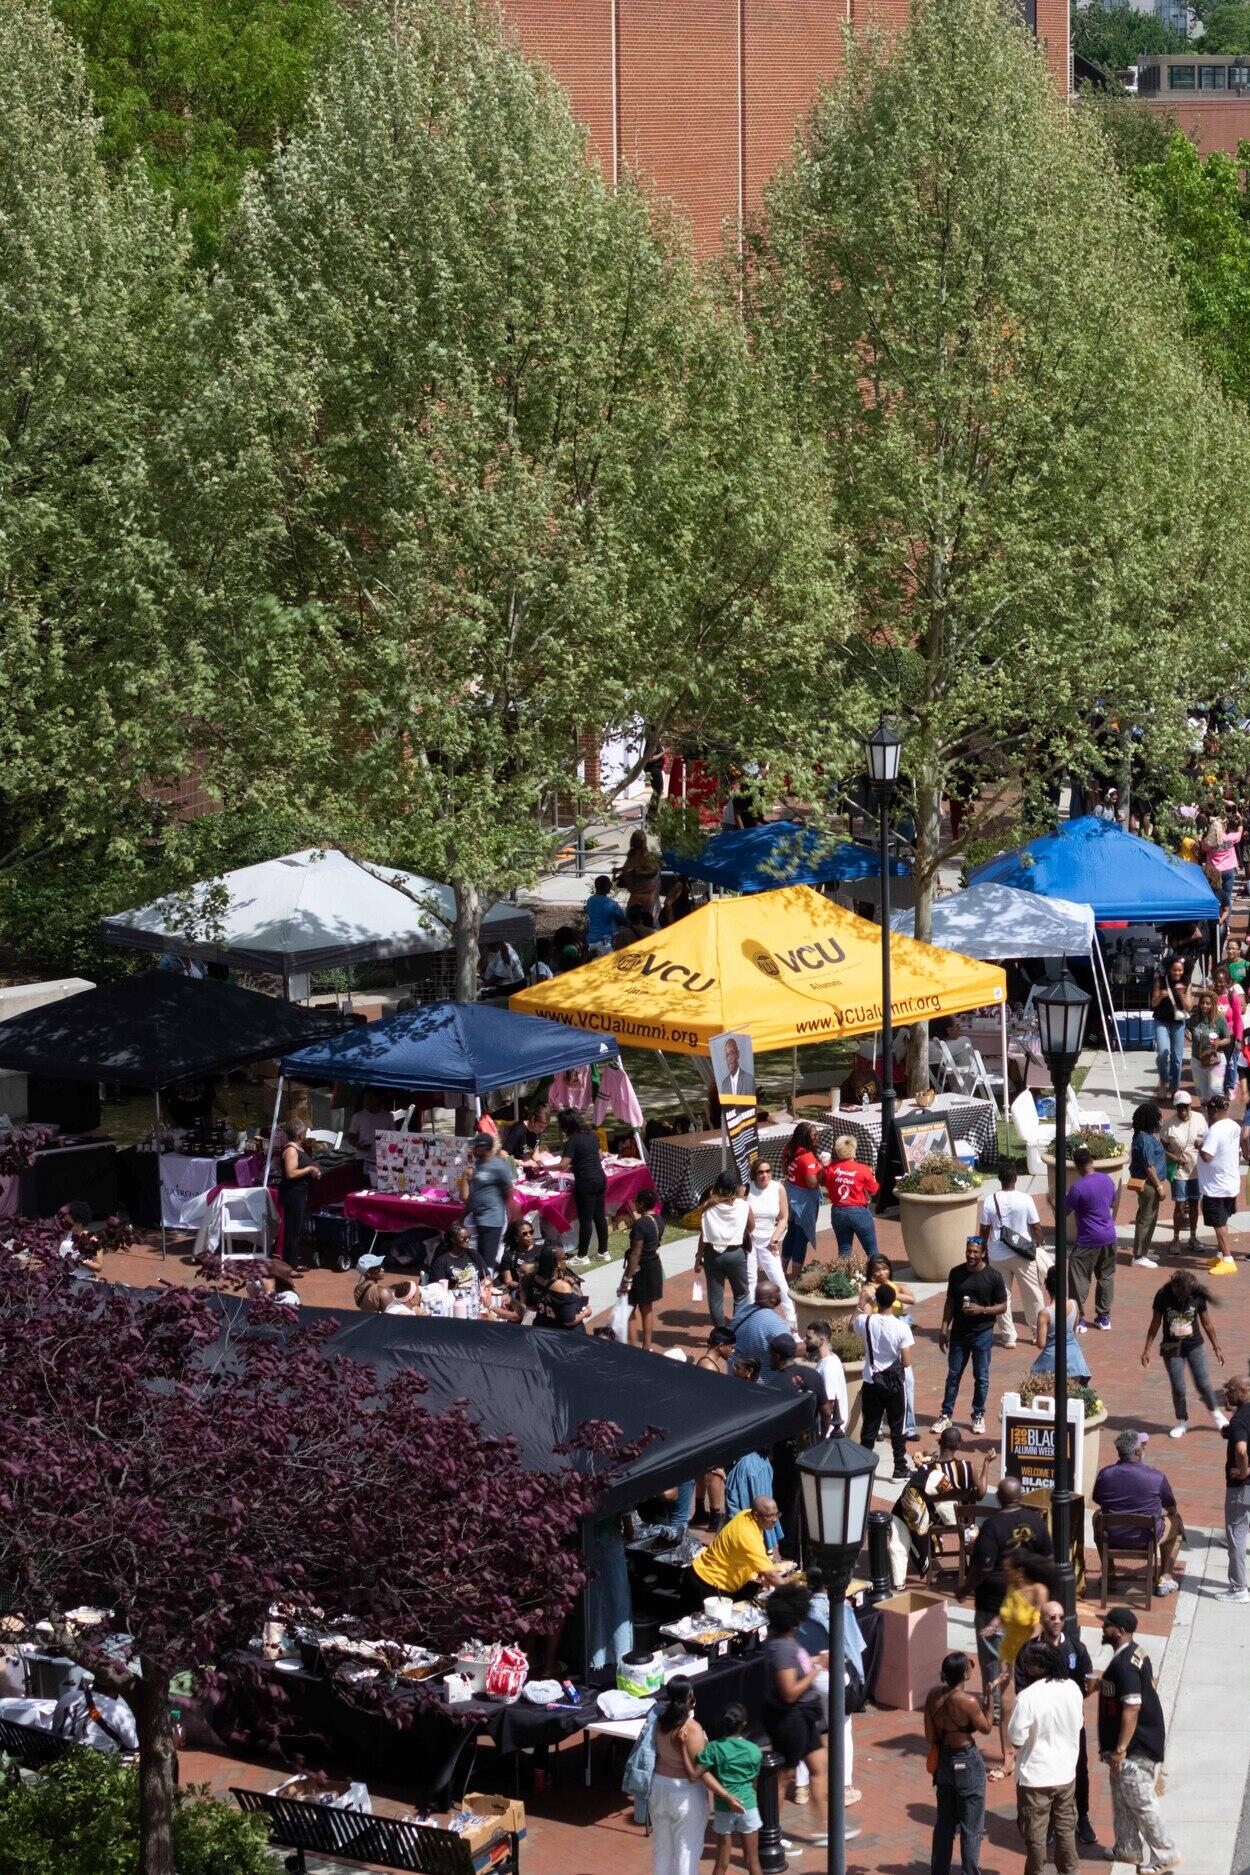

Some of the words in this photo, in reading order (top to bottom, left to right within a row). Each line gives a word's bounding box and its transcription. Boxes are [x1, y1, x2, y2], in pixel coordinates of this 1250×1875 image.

[774, 937, 846, 973] VCU
[641, 953, 716, 992] VCU
[810, 979, 843, 990] Alumni
[536, 1009, 699, 1047] www.VCUalumni.org
[1014, 1428, 1027, 1436] 20
[1027, 1429, 1055, 1447] BLAC
[1014, 1436, 1027, 1445] 25
[1014, 1445, 1038, 1455] ALUMNI
[1038, 1447, 1055, 1456] WEEK
[1021, 1466, 1050, 1477] WELCOME
